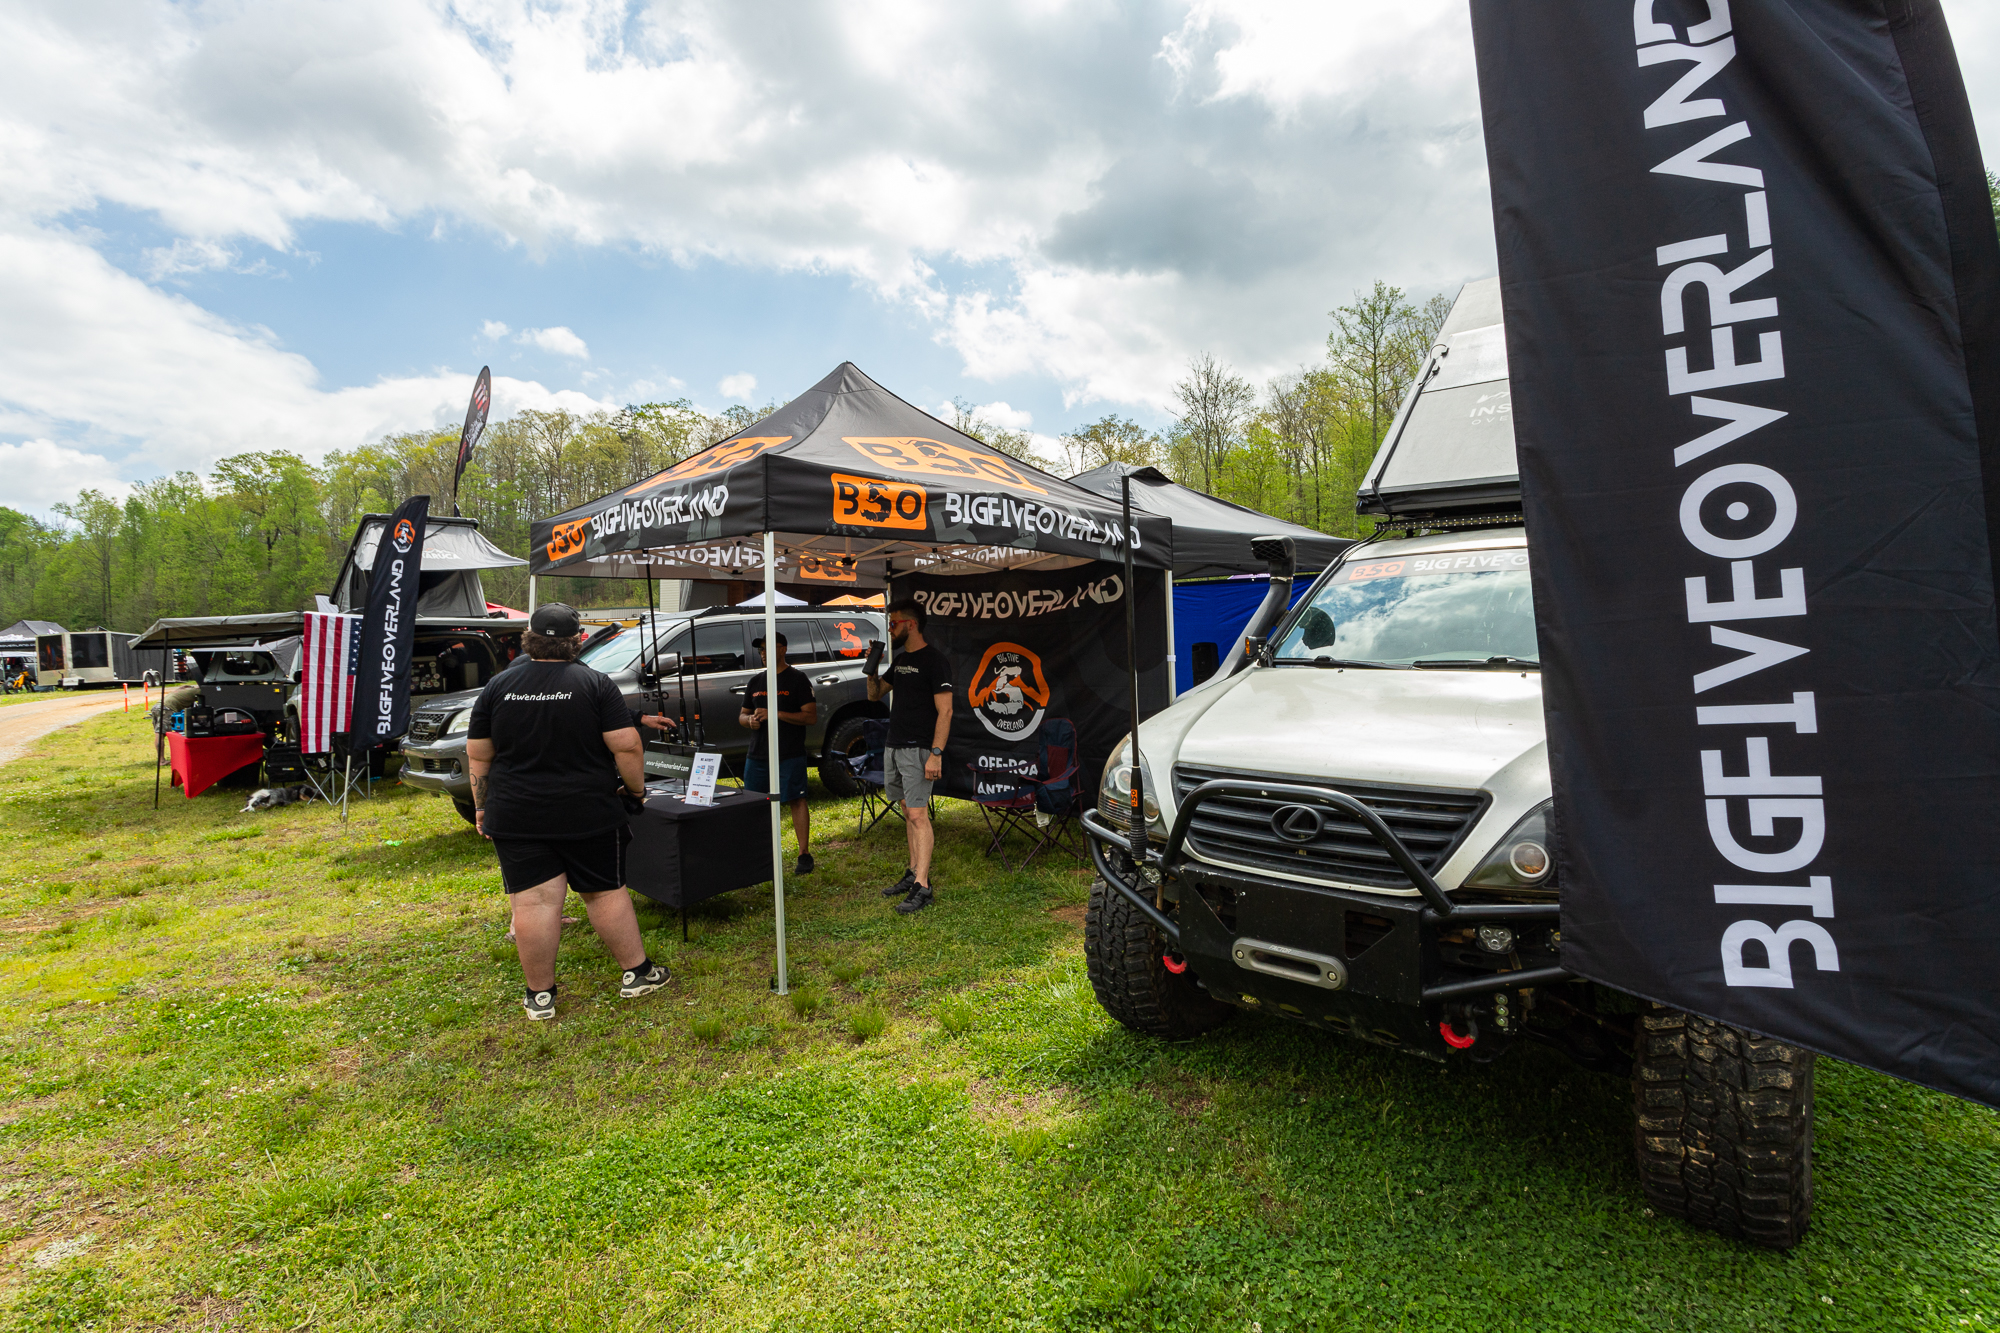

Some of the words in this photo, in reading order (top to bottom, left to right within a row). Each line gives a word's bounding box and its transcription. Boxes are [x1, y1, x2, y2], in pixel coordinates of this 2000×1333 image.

[590, 485, 729, 540] BIGFIVEOVERLAND
[1413, 558, 1450, 571] BIG
[1453, 554, 1504, 569] FIVE
[914, 574, 1124, 619] BIGFIVEOVERLAND
[377, 559, 404, 734] BIGFIVEOVERLAND
[996, 718, 1025, 731] OVERLAND
[1268, 945, 1293, 954] FACTOR
